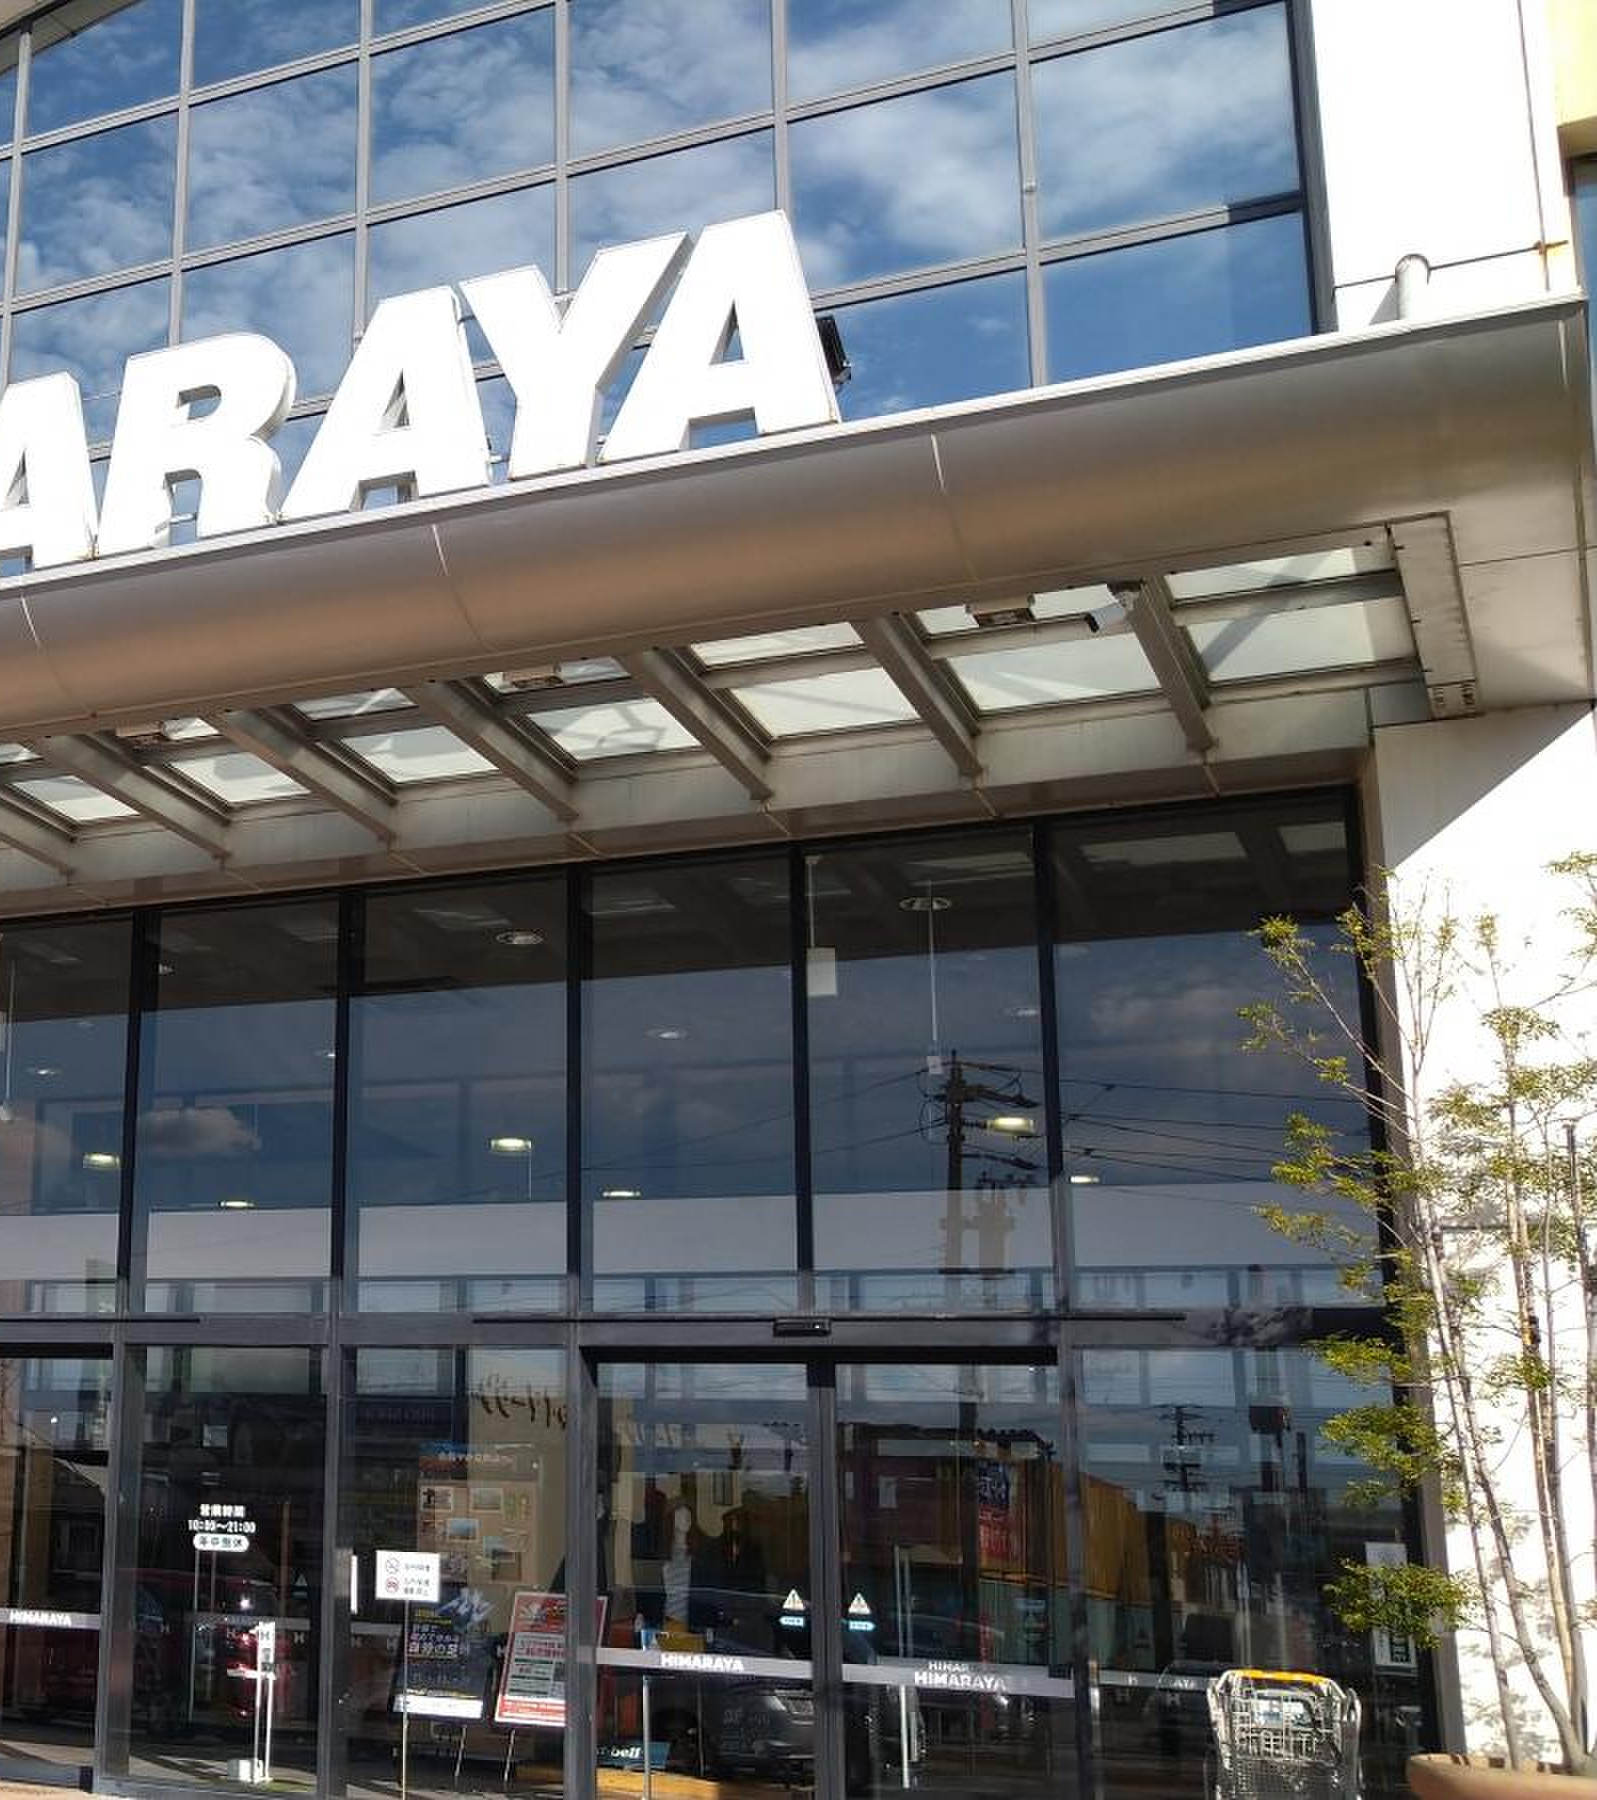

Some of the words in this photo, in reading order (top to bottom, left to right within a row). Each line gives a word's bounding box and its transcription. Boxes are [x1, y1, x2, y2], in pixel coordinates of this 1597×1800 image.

[9, 1608, 72, 1627] HIMARAYA
[661, 1652, 744, 1672] HIMARAYA
[915, 1671, 1007, 1692] HIMARAYA
